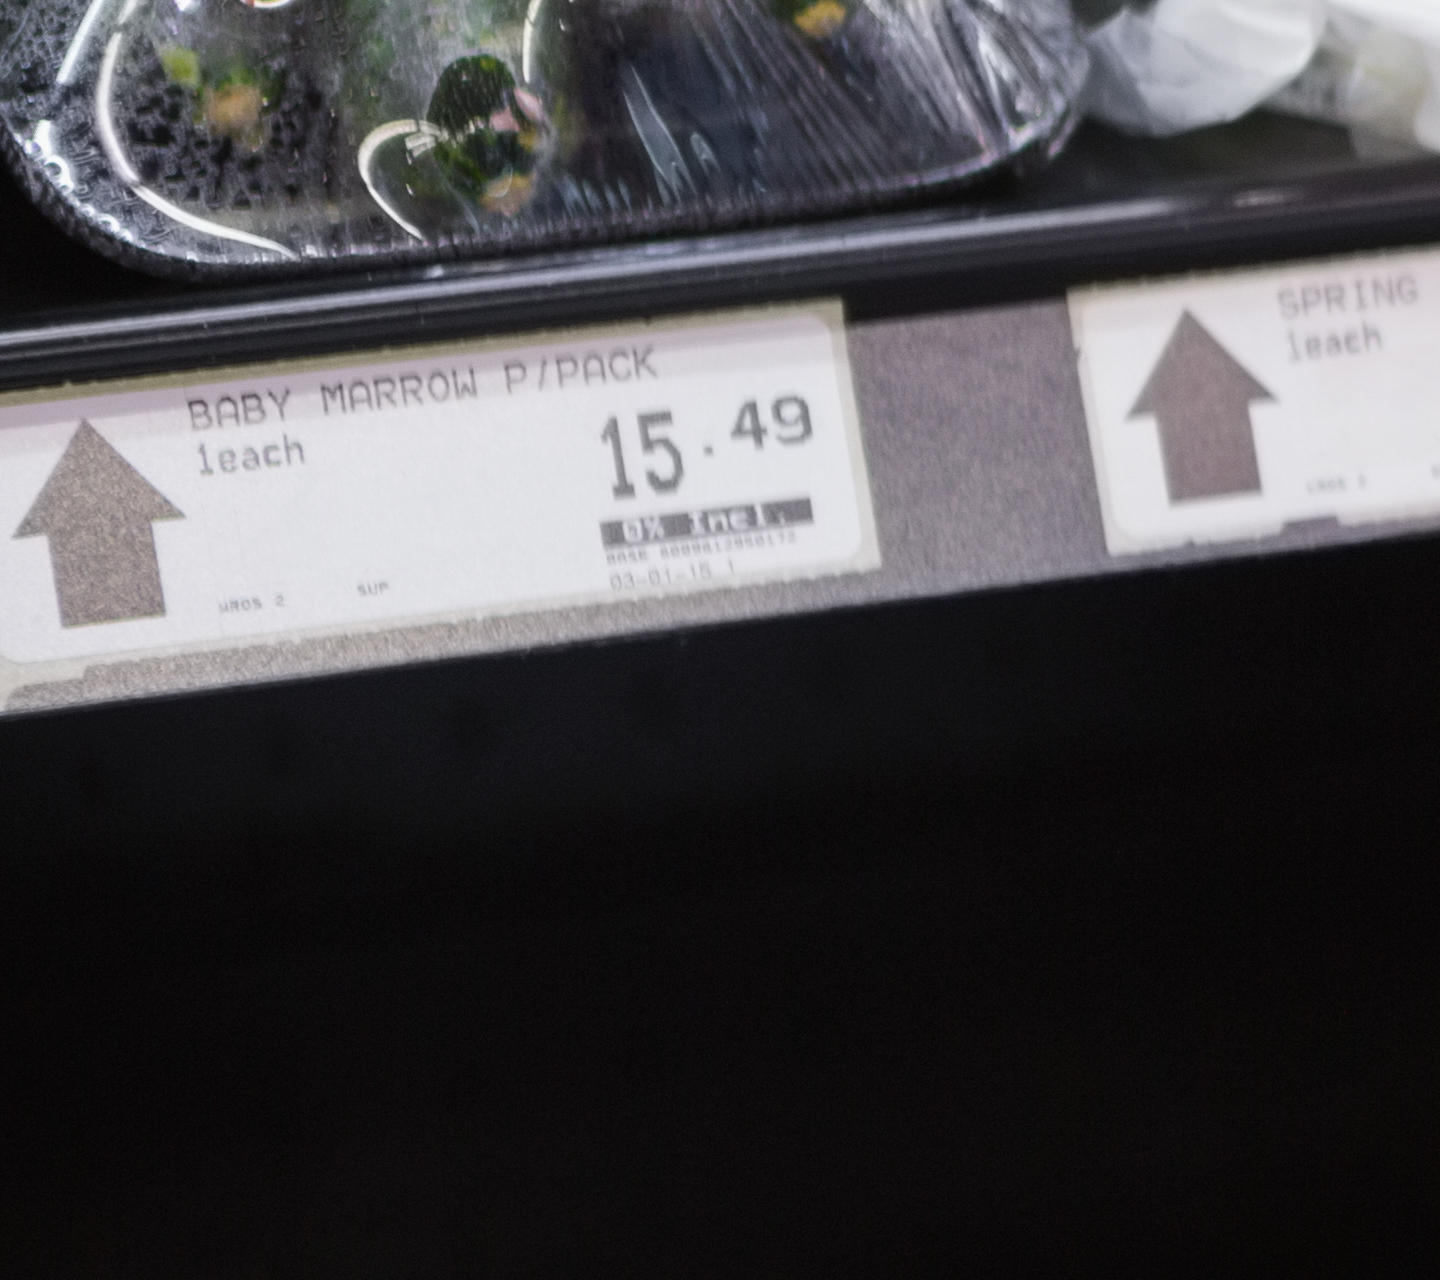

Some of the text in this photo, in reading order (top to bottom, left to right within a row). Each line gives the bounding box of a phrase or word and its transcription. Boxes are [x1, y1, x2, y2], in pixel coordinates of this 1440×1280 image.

[1277, 266, 1420, 320] SPRING
[187, 345, 659, 431] BABY MARROW P/PACK
[198, 432, 306, 476] 1each
[600, 394, 814, 500] 15.49
